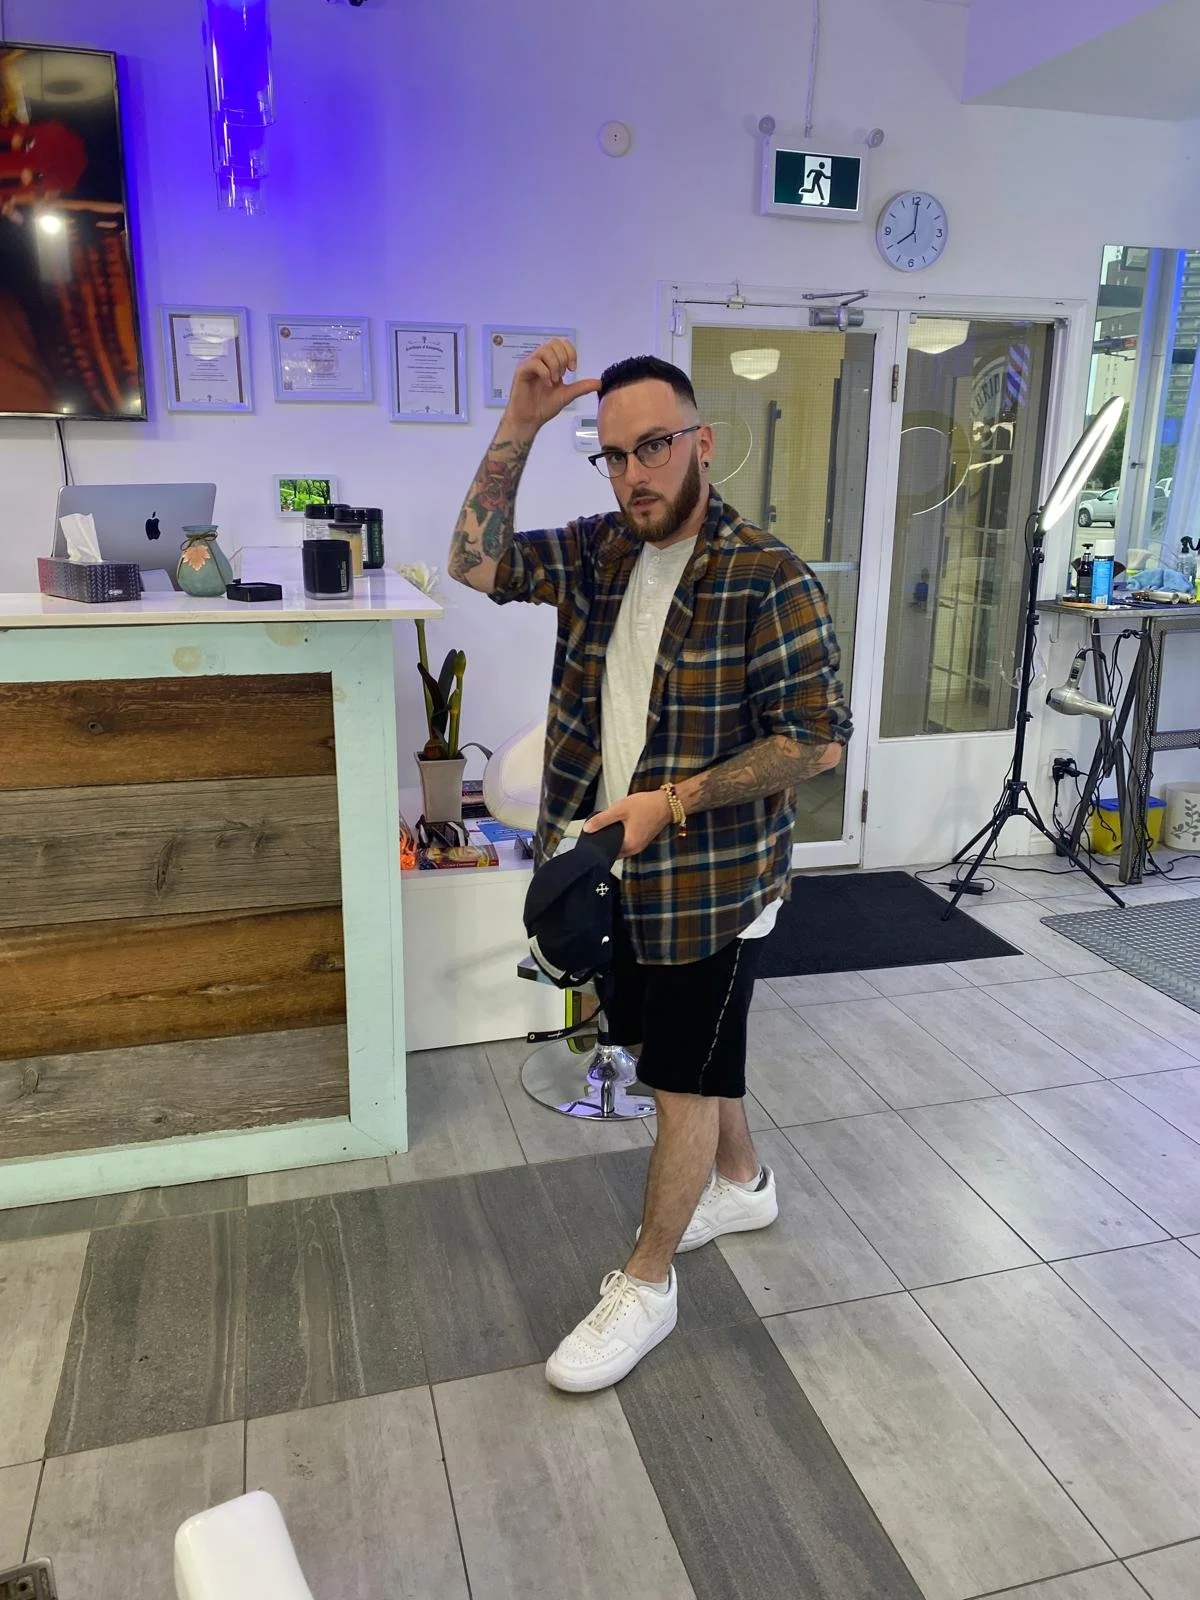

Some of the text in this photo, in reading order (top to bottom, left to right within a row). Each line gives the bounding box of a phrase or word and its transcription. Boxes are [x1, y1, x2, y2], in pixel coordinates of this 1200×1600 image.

[912, 196, 922, 206] 12
[884, 226, 892, 236] 9
[936, 228, 942, 238] 3
[908, 258, 914, 268] 6
